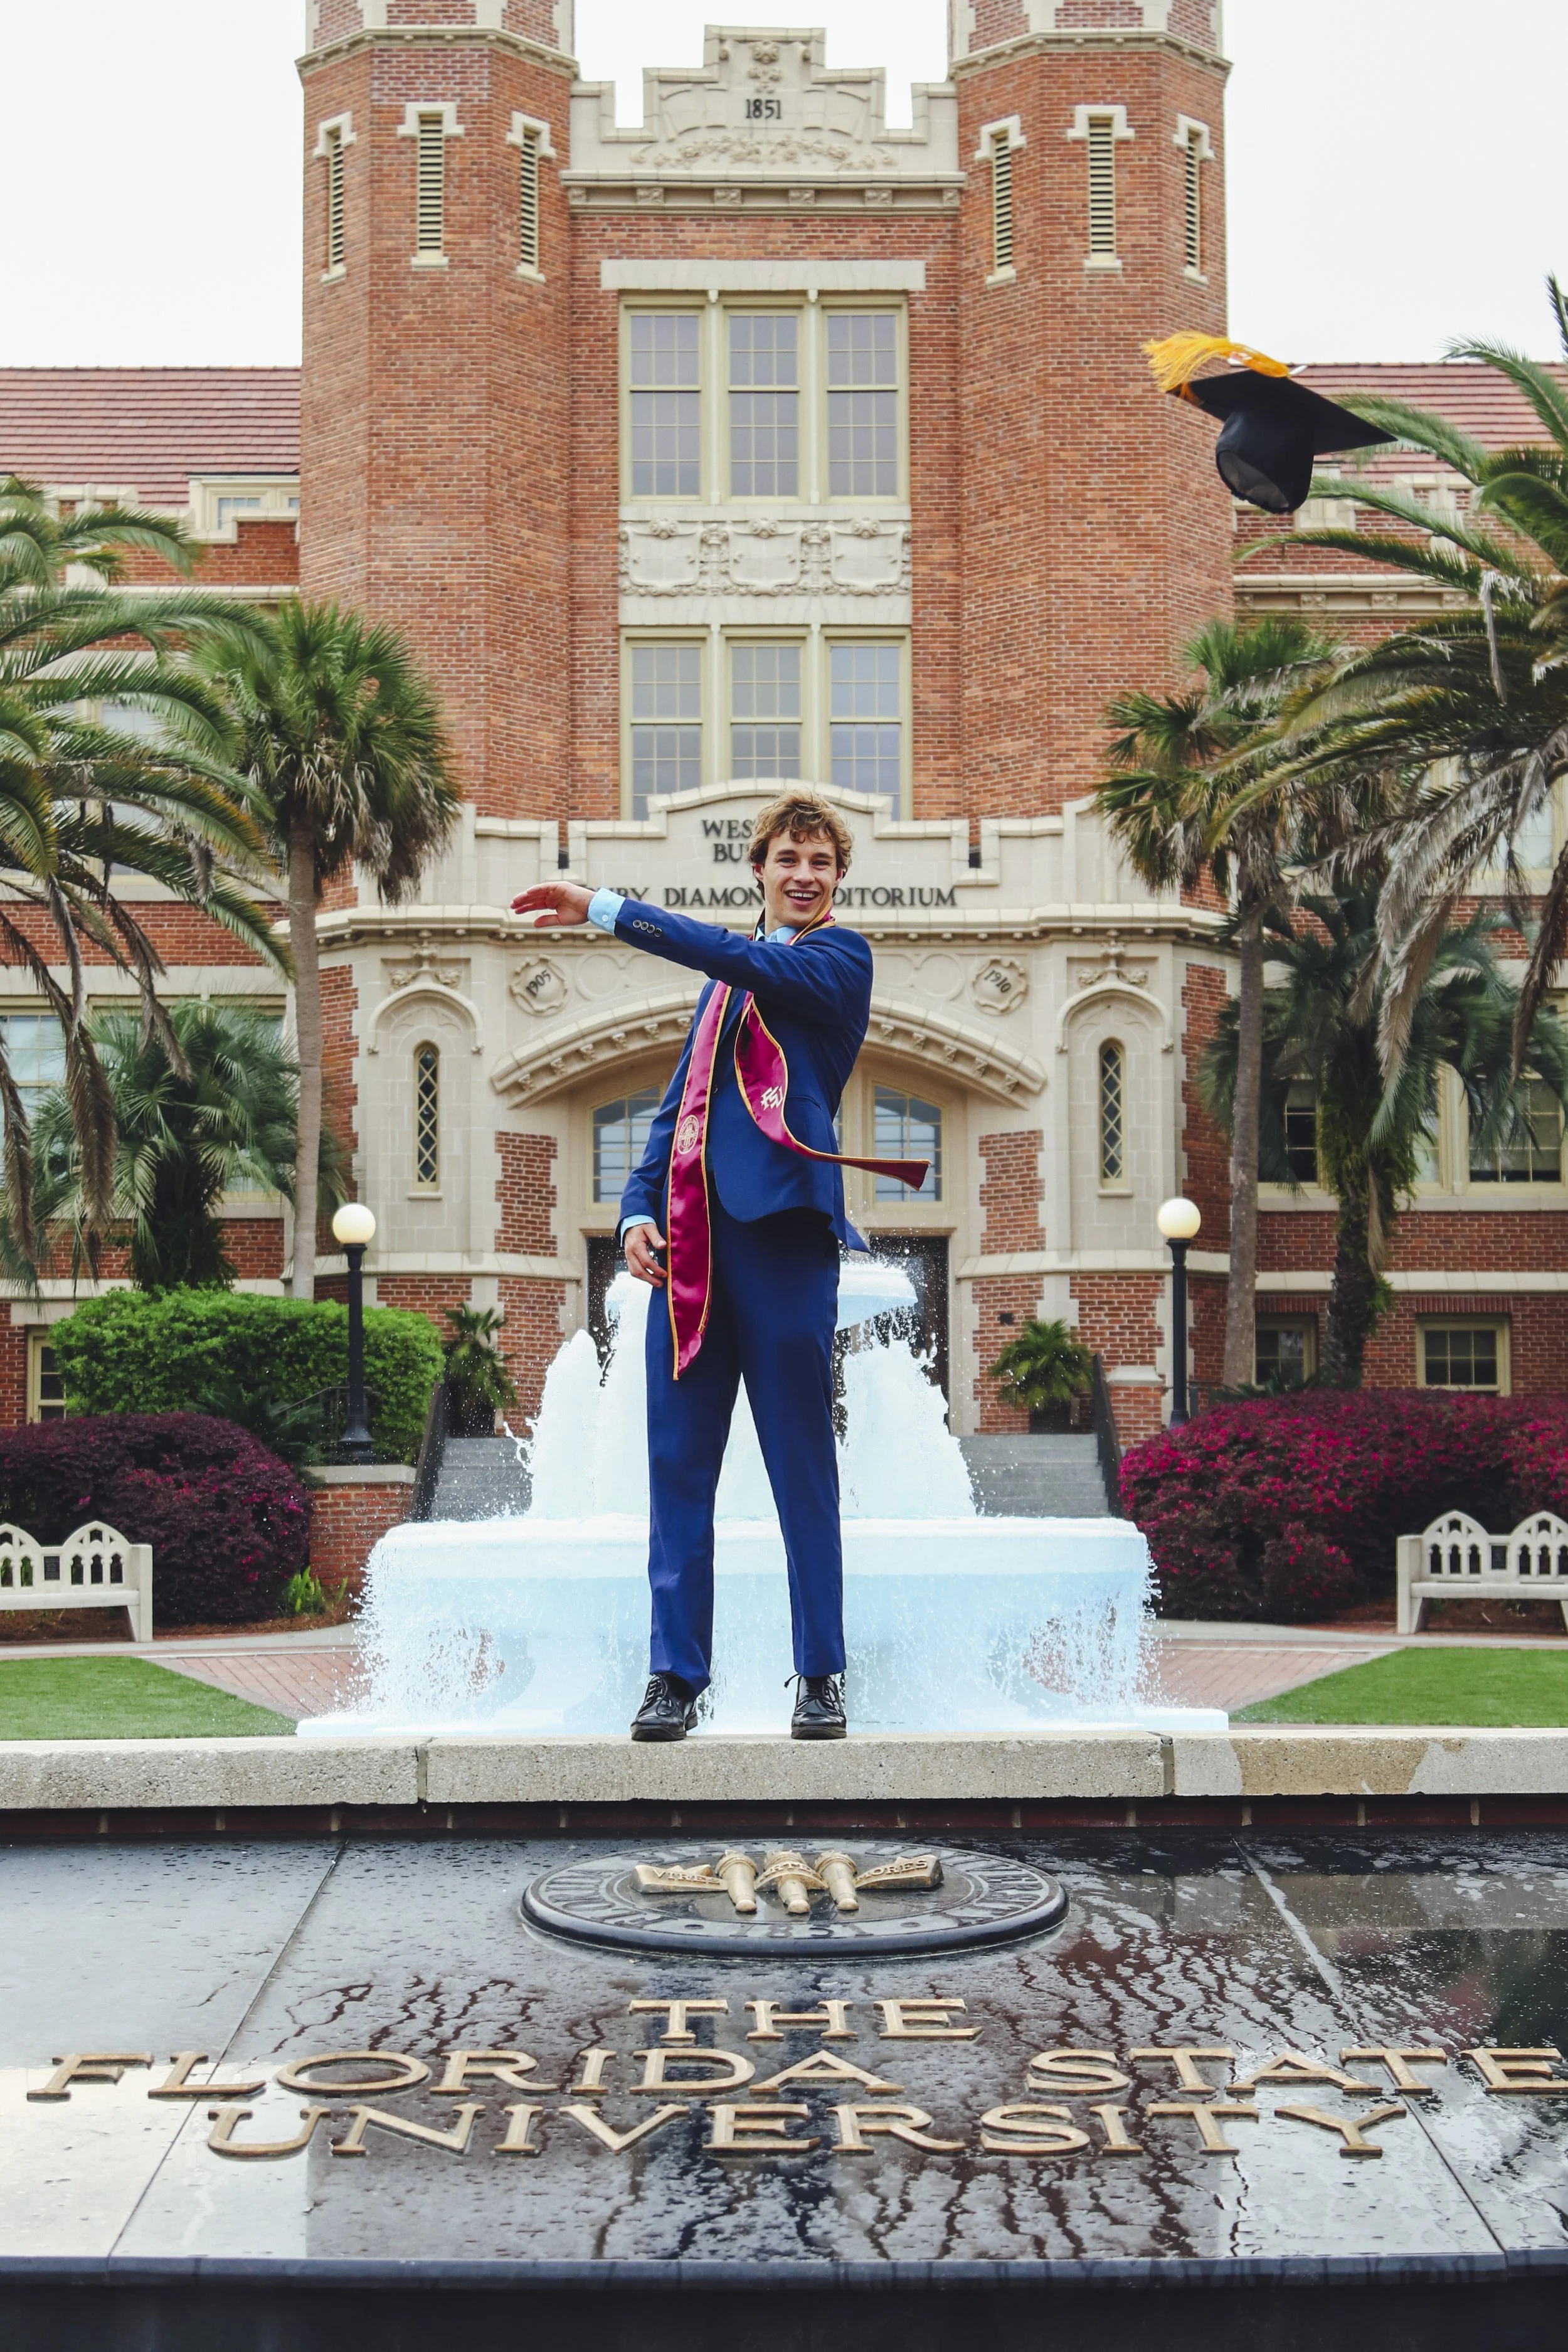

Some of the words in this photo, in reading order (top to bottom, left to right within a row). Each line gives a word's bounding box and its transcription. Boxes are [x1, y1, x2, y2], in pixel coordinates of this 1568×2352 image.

[745, 98, 781, 119] 1851
[701, 819, 755, 839] WES
[664, 886, 764, 907] DIAMON
[834, 886, 957, 907] DITORIUM
[526, 970, 551, 998] 1905
[983, 970, 1012, 993] 1910
[760, 1086, 783, 1111] FSU
[729, 1922, 874, 1938] 1851
[628, 1998, 983, 2041] THE
[26, 2048, 905, 2102] FLORIDA
[1025, 2047, 1568, 2095] STATE
[207, 2102, 1407, 2158] UNIVERSITY
